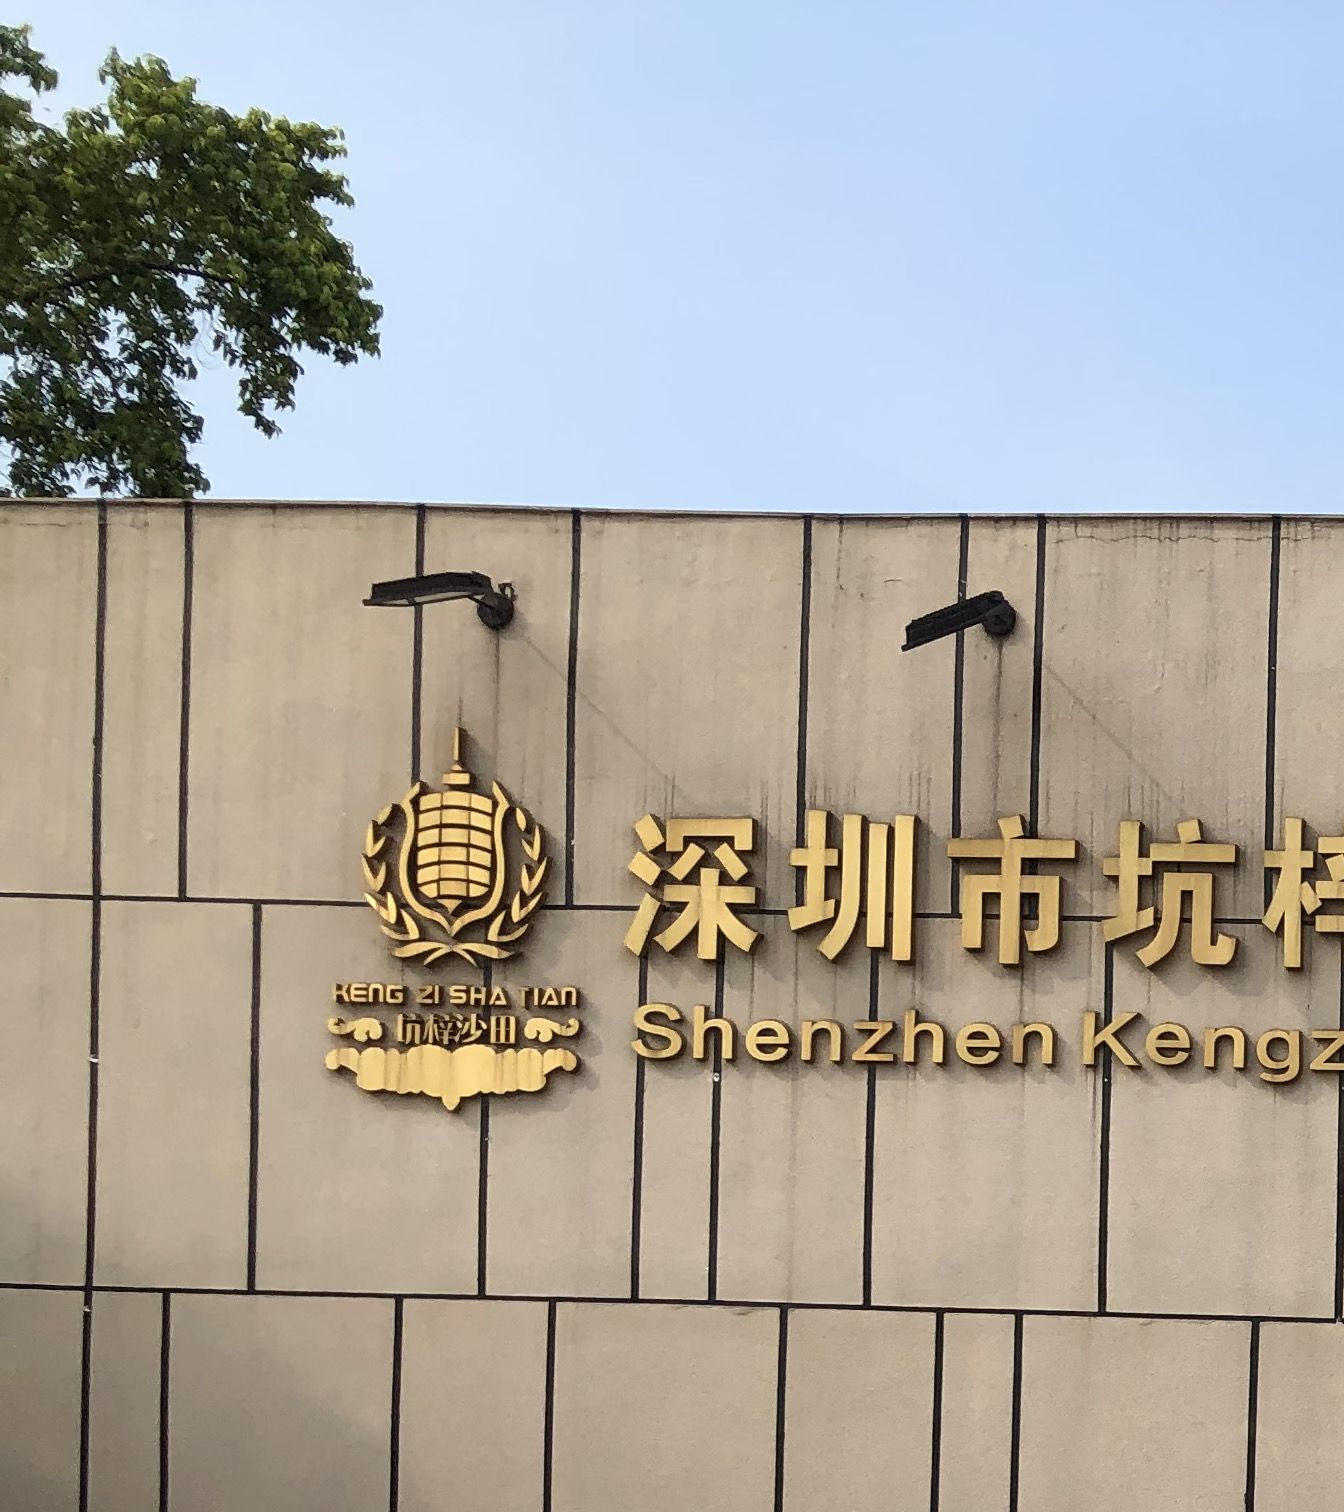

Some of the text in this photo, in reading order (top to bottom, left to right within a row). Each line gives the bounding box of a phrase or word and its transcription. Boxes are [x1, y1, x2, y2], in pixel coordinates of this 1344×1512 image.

[334, 983, 578, 1008] KENG ZI SHA TIAN
[396, 1013, 518, 1046] 坑梓沙田
[631, 1002, 1057, 1067] Shenzhen
